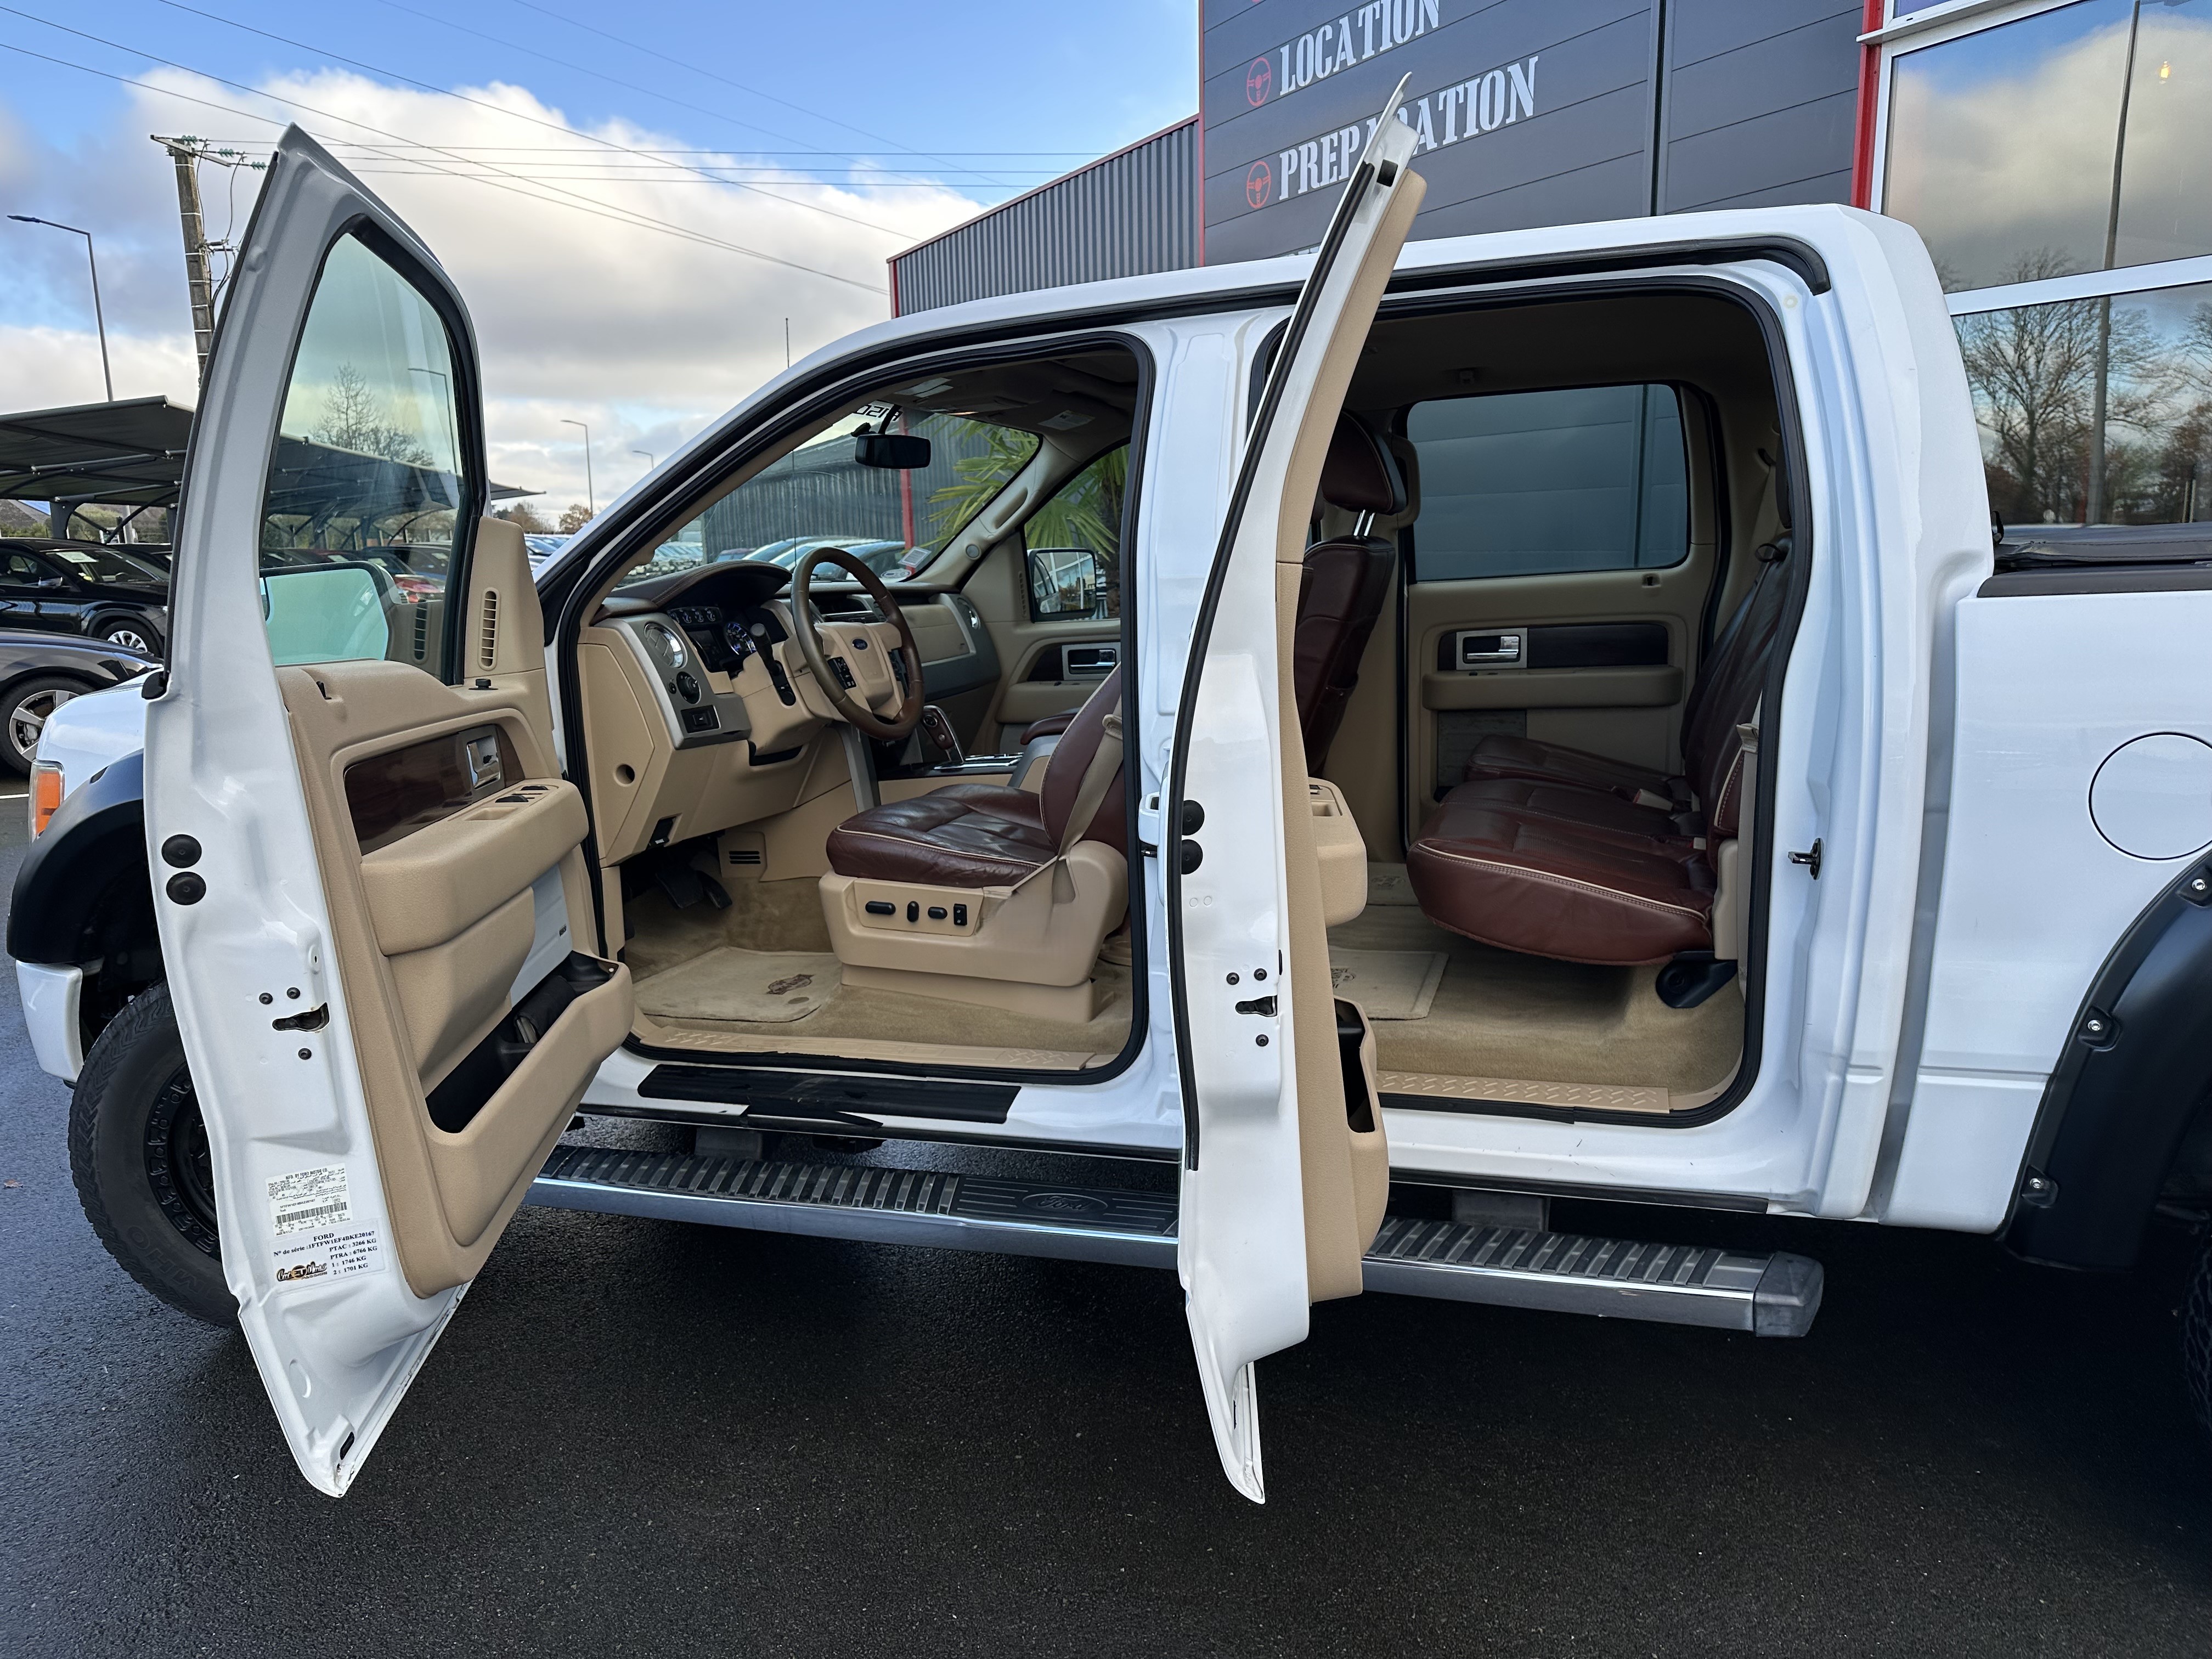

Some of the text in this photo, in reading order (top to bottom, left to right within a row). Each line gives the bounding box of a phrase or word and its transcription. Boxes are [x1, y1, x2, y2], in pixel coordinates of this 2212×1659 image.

[1280, 0, 1439, 95] LOCATION
[1279, 56, 1538, 200] PREPATION
[1036, 1196, 1088, 1211] Ford
[313, 1233, 334, 1242] FORD
[329, 1244, 347, 1252] PTAC
[330, 1251, 348, 1260] PTRA
